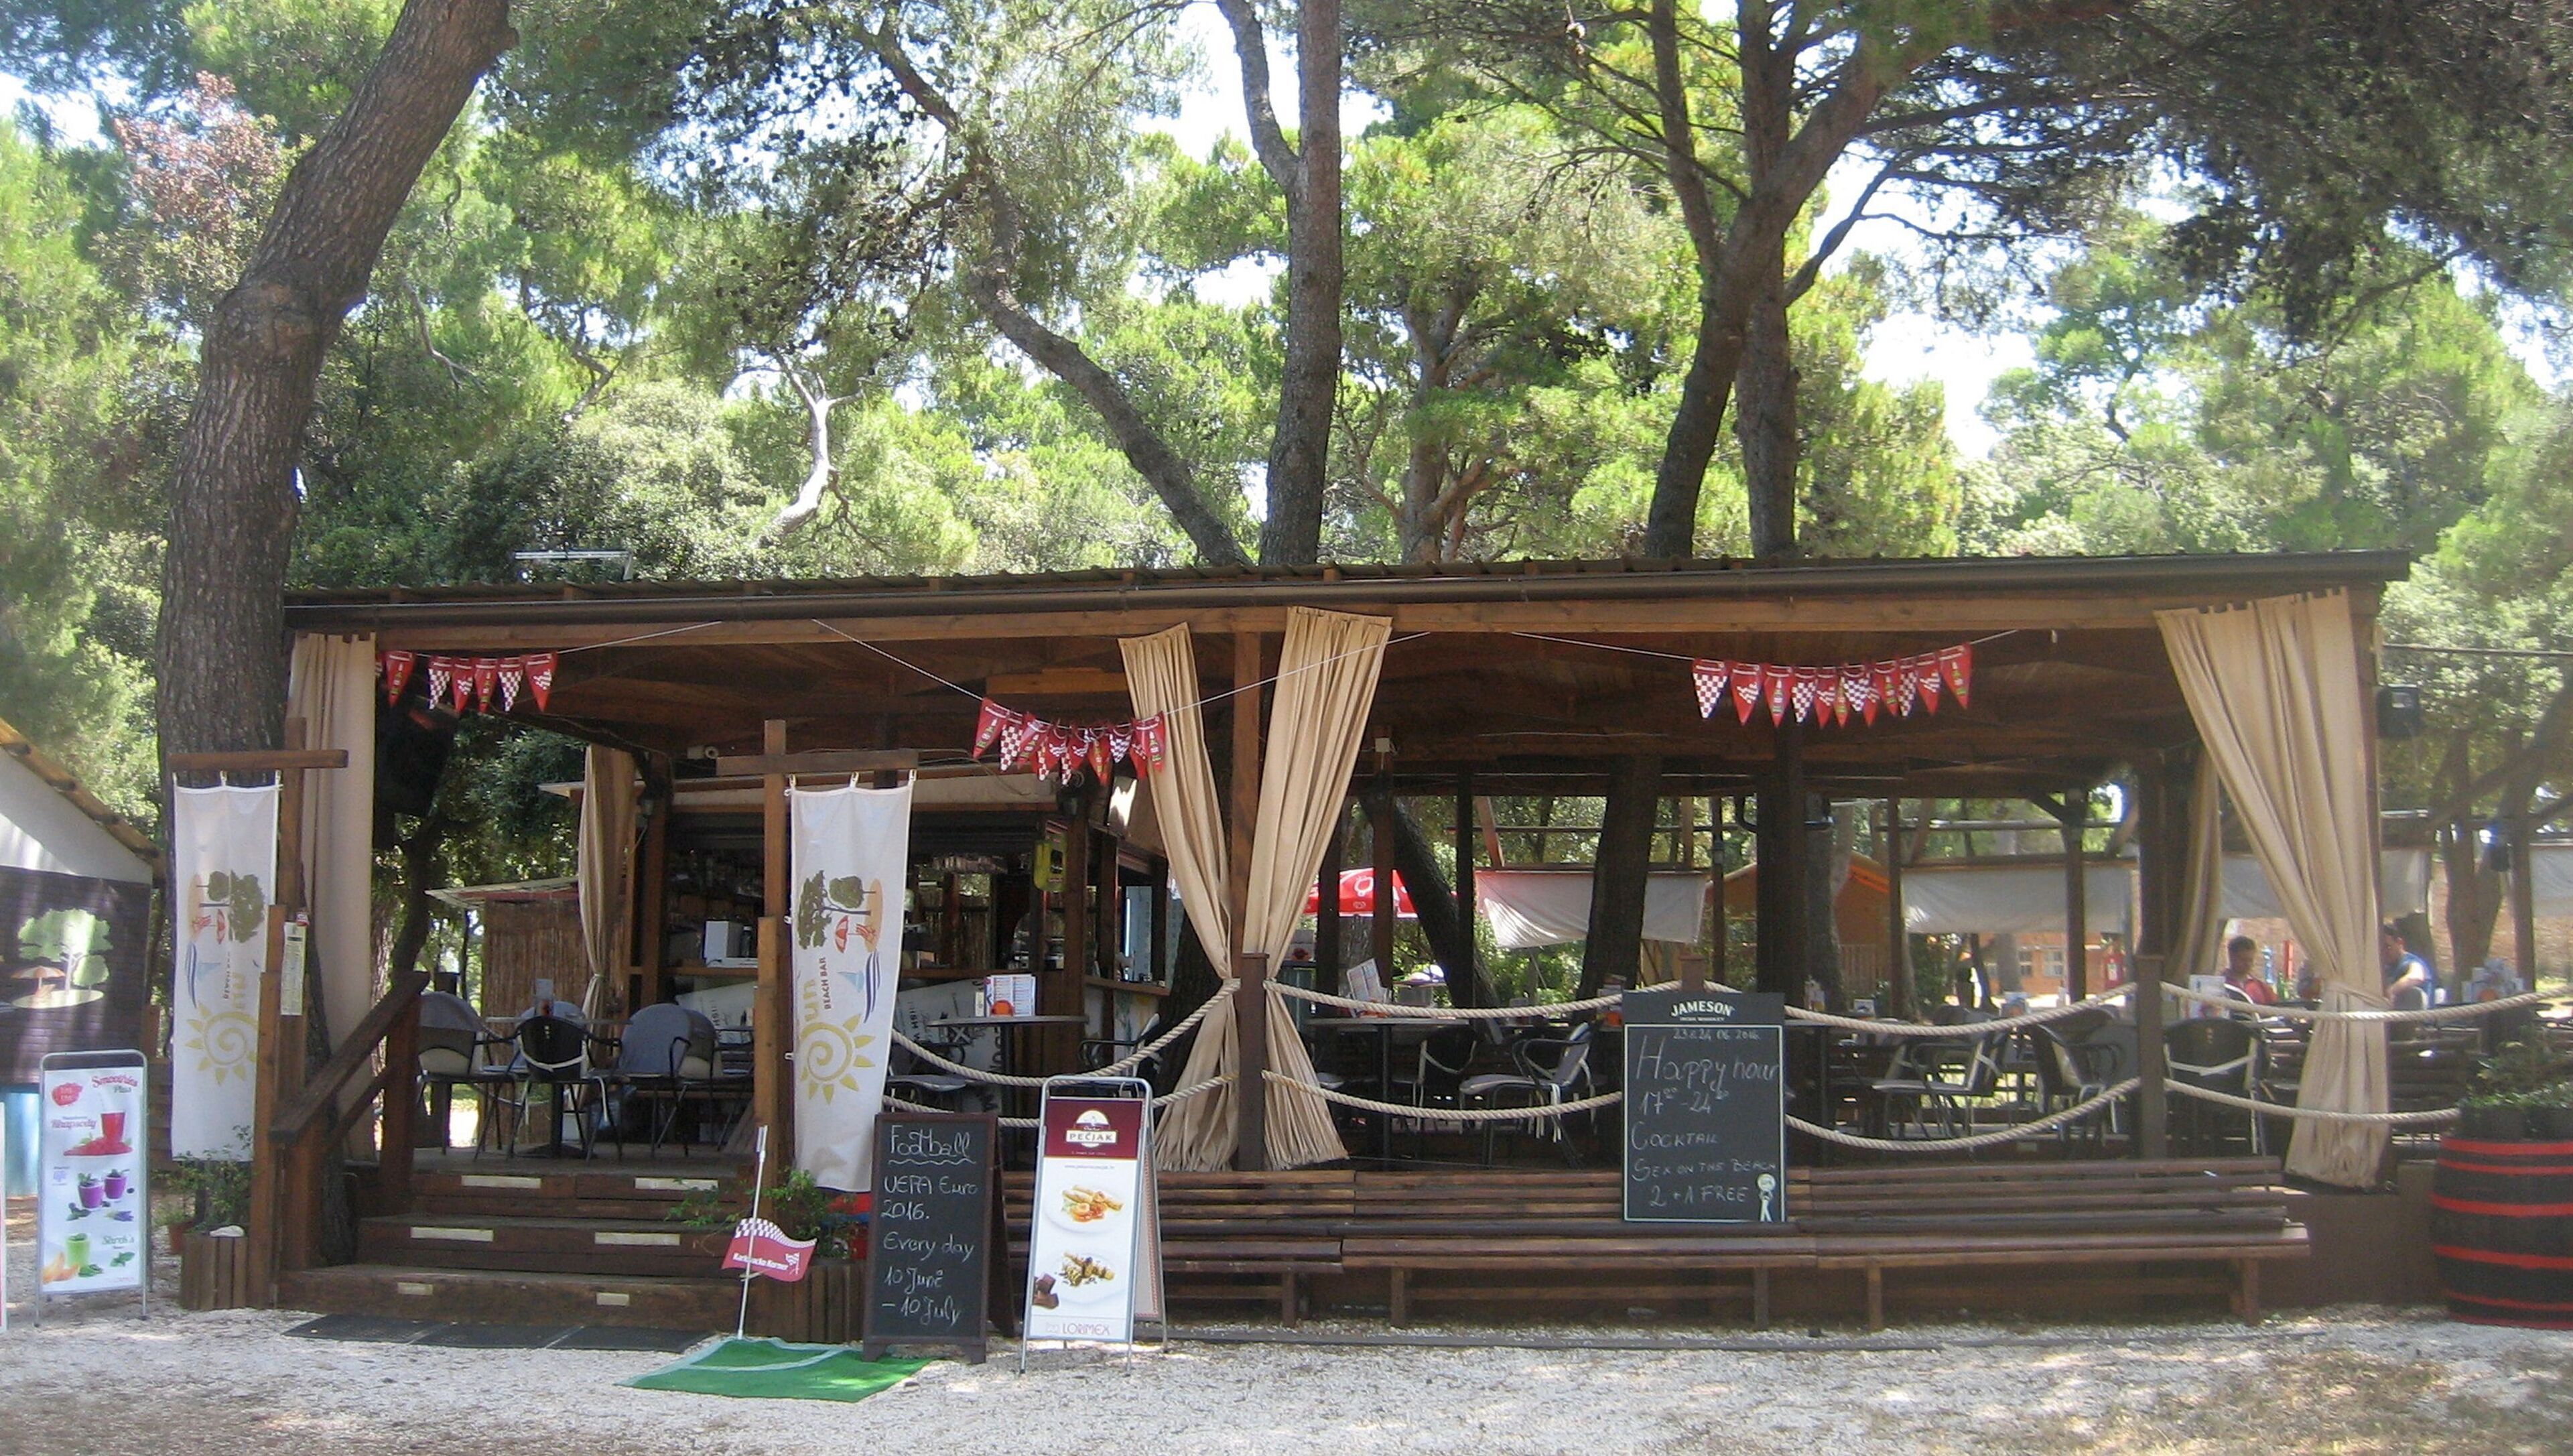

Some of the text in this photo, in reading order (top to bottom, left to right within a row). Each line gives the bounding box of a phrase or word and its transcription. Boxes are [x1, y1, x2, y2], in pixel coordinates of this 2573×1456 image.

[818, 957, 832, 1010] BEACH BAR
[1671, 1000, 1734, 1016] JAMESON
[1636, 1036, 1779, 1091] Happy hour
[890, 1124, 970, 1158] Football
[1069, 1132, 1112, 1142] PEČJAK
[884, 1175, 978, 1195] UEFA Euro
[1701, 1185, 1748, 1202] FREE
[883, 1232, 974, 1262] Every day
[884, 1266, 944, 1294] 10 June
[901, 1296, 921, 1317] 10
[920, 1295, 962, 1327] July
